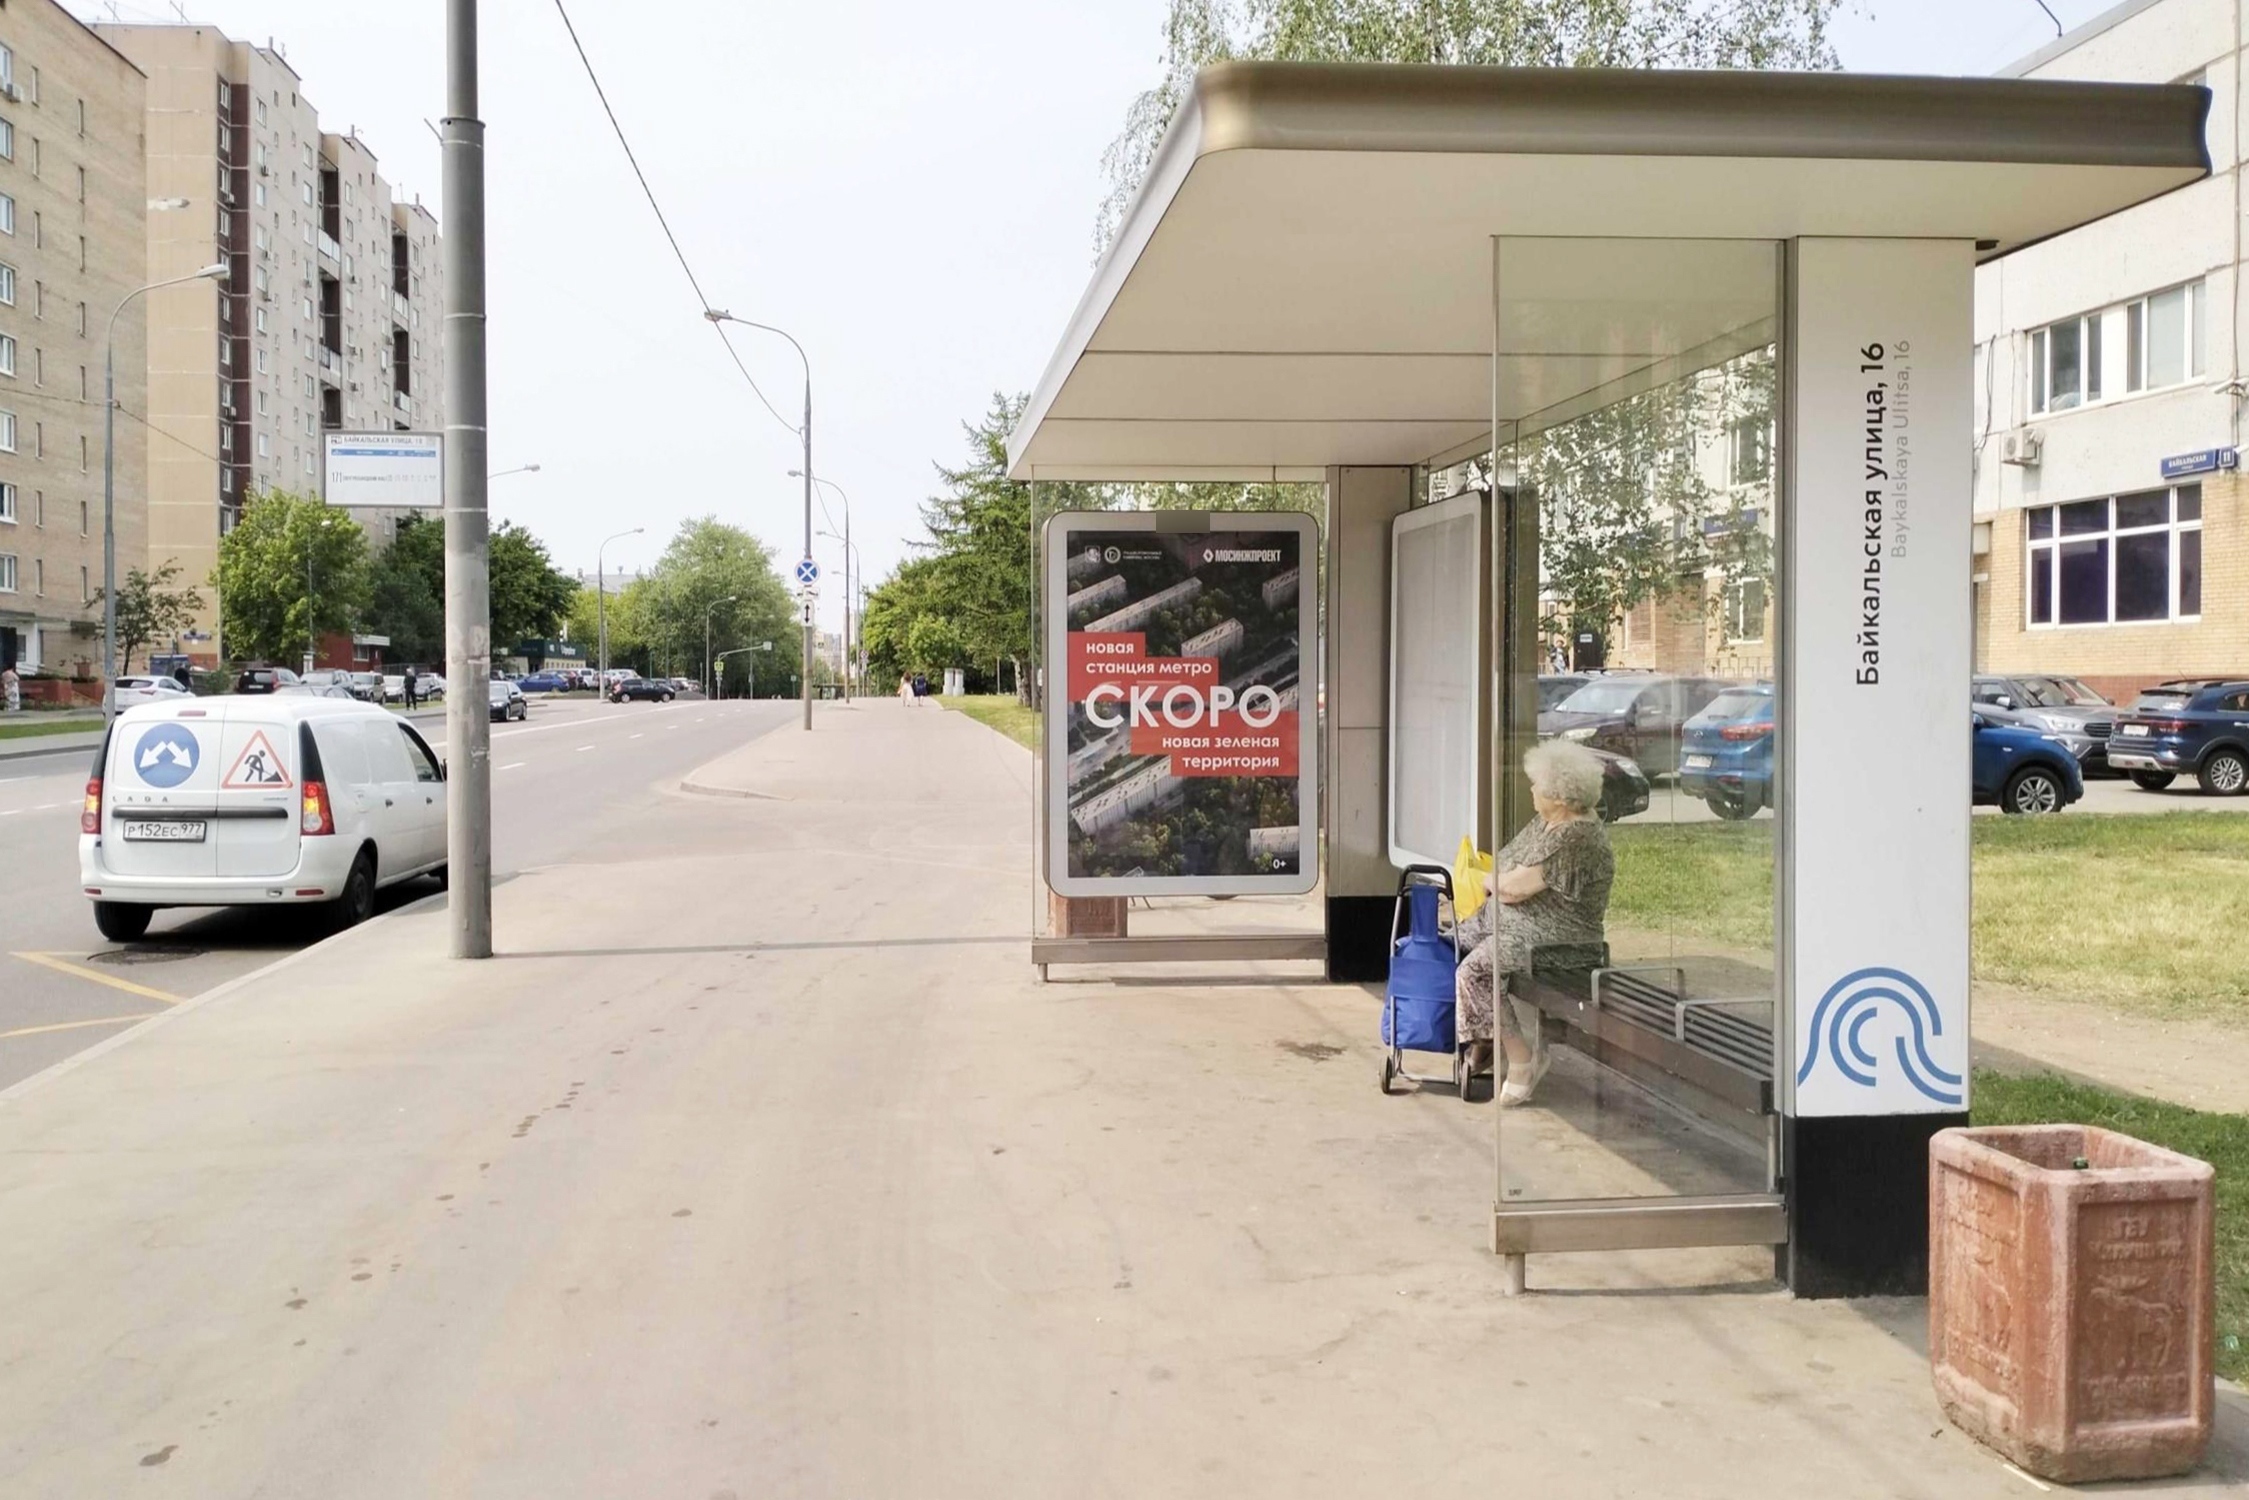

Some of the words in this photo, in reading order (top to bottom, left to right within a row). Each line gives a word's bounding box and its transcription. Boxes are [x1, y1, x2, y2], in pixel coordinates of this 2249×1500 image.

[1861, 343, 1884, 373] 16
[1894, 340, 1910, 360] 16
[1893, 366, 1912, 429] Ulitsa,
[1865, 382, 1888, 480] улица,
[2223, 451, 2231, 462] 11
[1891, 436, 1912, 557] Baykalskaya
[1215, 549, 1281, 562] МОСИНЖПРОЕКТ
[1856, 490, 1882, 685] Байкальская
[1086, 642, 1134, 654] новая
[1086, 662, 1154, 675] станция
[1159, 662, 1212, 677] метро
[1085, 684, 1281, 728] СКОРО
[1162, 736, 1210, 748] новая
[1215, 736, 1280, 748] зеленая
[1182, 756, 1280, 770] территория
[1272, 859, 1287, 869] 0+
